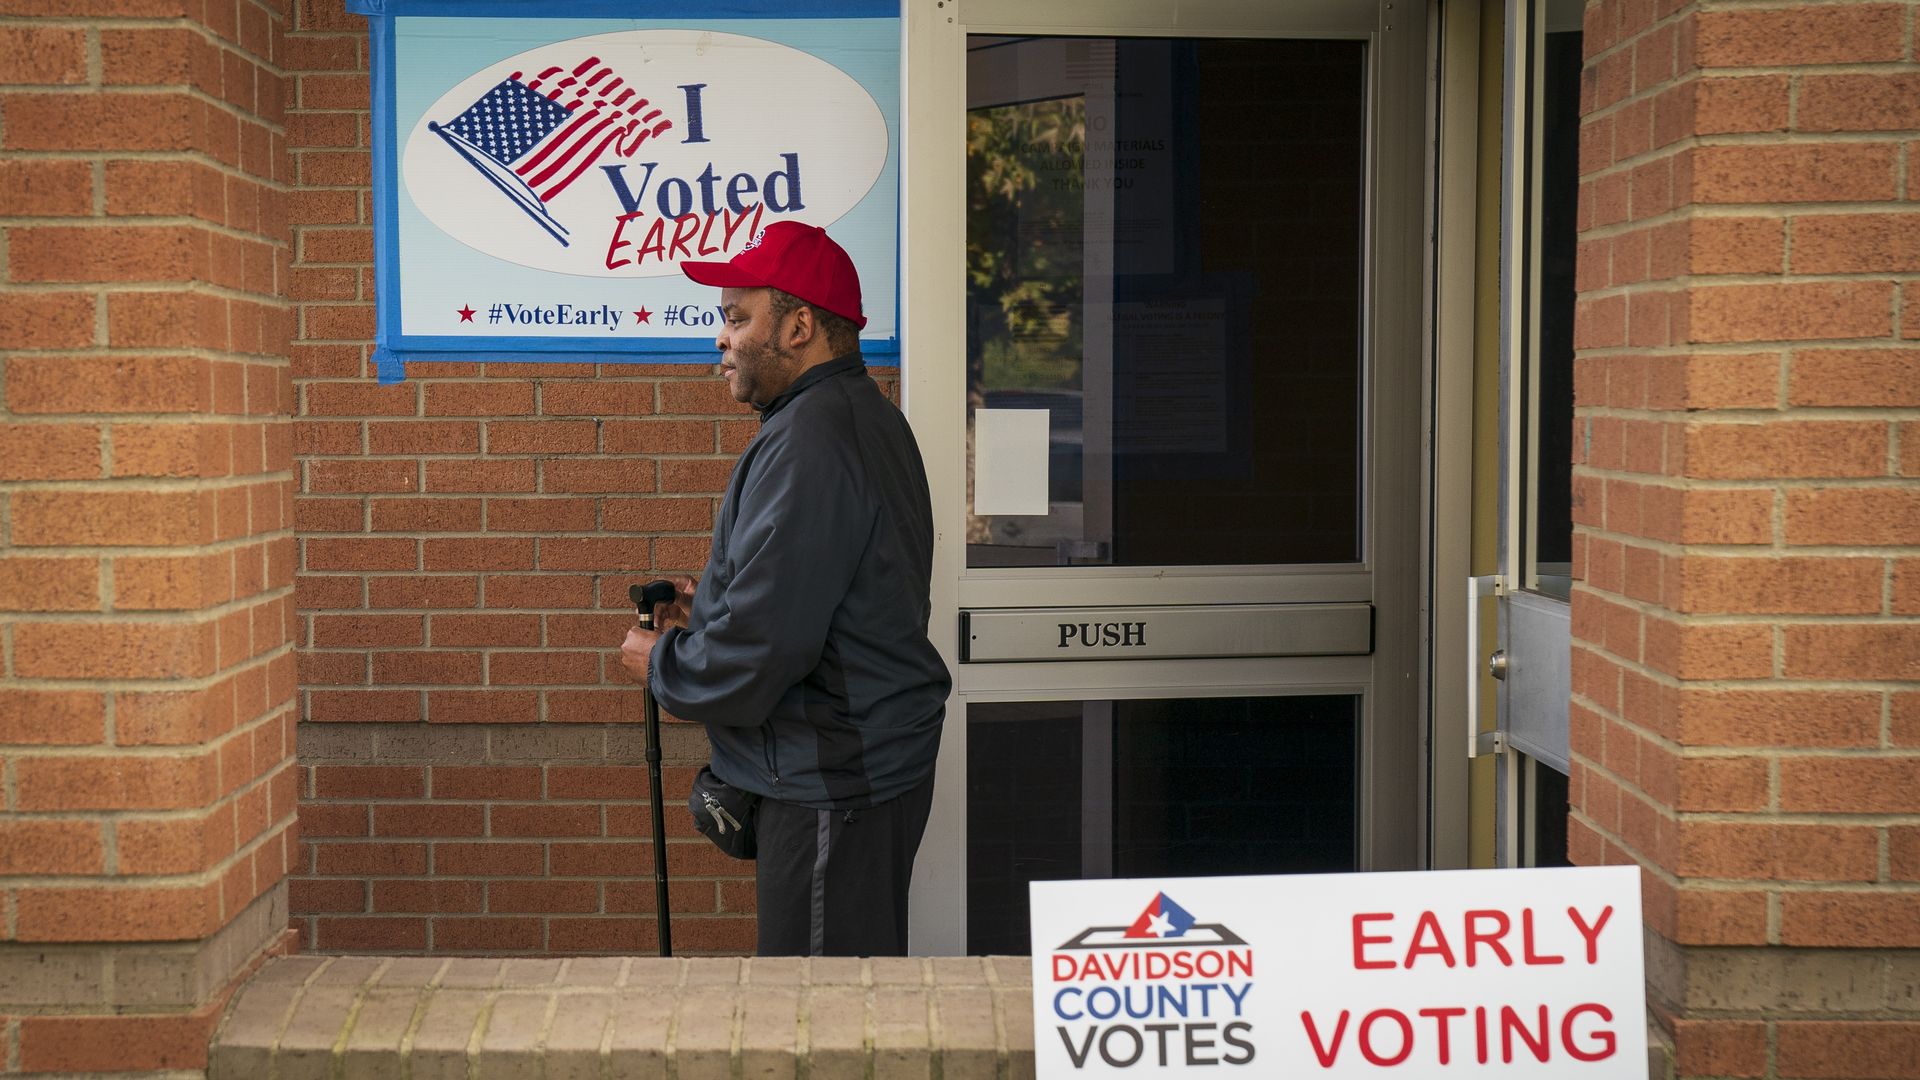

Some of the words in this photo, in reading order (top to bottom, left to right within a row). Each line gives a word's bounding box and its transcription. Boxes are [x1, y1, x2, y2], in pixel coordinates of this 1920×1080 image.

[677, 84, 711, 144] I
[1021, 142, 1093, 155] CAMIGN
[1094, 140, 1165, 153] MATERIALS
[1040, 159, 1102, 171] ALLOWED
[1106, 159, 1145, 170] INSIDE
[599, 153, 805, 222] Voted
[1052, 178, 1099, 191] THANK
[1105, 178, 1134, 190] YOU
[606, 202, 764, 270] EARLY!
[489, 303, 623, 331] #VoteEarly
[664, 304, 727, 327] #GoV
[1058, 622, 1146, 647] PUSH
[1352, 905, 1614, 970] EARLY
[1052, 949, 1253, 982] DAVIDSON
[1053, 983, 1253, 1020] COUNTY
[1057, 1022, 1256, 1069] VOTES
[1301, 1003, 1617, 1068] VOTING
